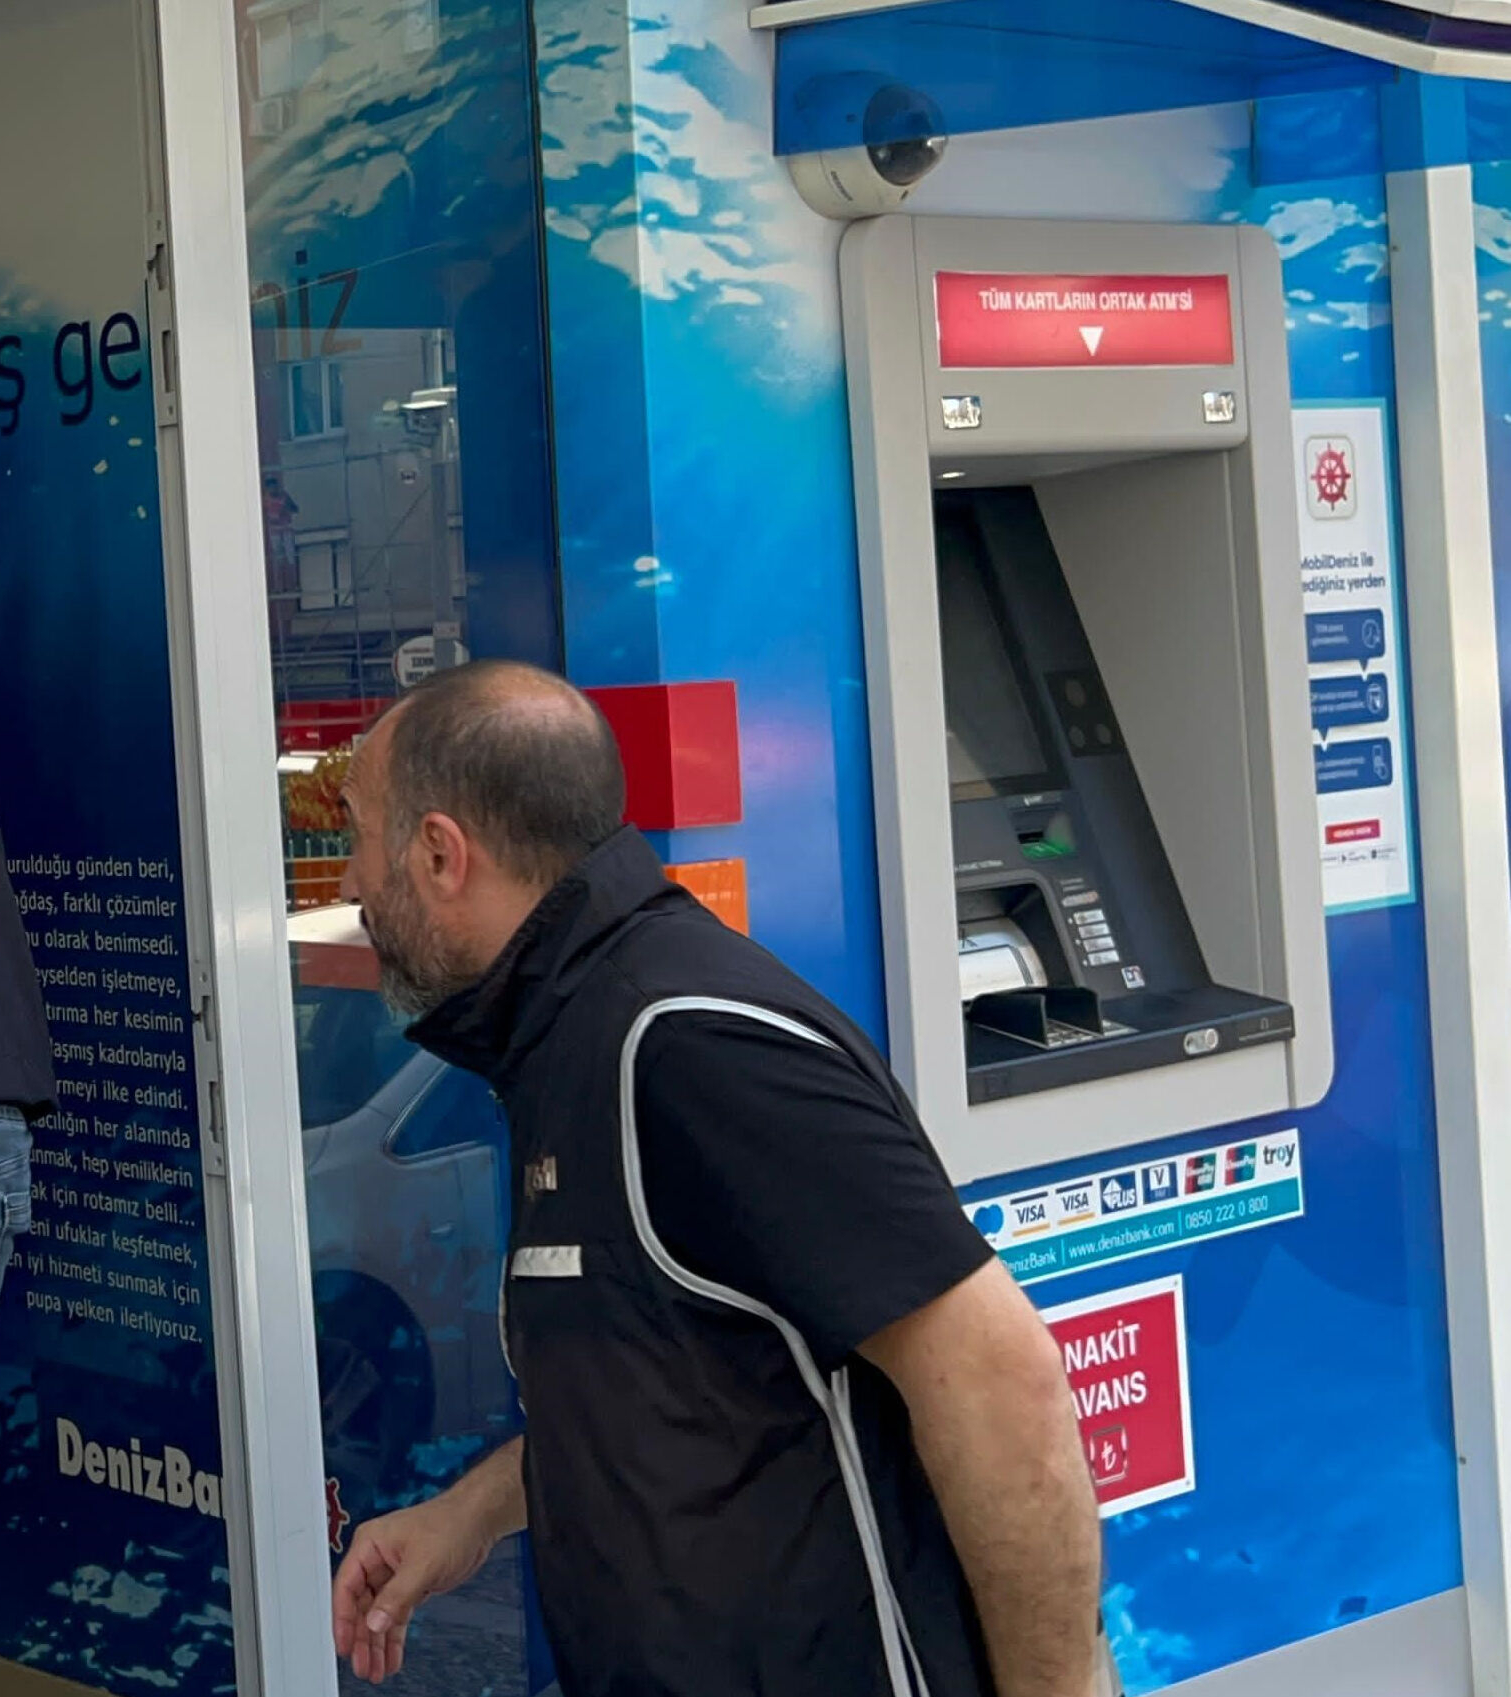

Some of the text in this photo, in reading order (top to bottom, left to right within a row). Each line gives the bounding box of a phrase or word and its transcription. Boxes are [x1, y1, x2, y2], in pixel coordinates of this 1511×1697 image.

[979, 288, 1012, 311] TÜM
[1015, 291, 1096, 311] KARTLARIN
[1100, 291, 1146, 311] ORTAK
[53, 311, 150, 427] ge
[1348, 573, 1386, 592] yerden
[76, 857, 132, 880] günden
[138, 857, 174, 883] beri,
[63, 891, 101, 914] farklı
[106, 894, 177, 919] çözümler
[45, 929, 89, 949] olarak
[95, 931, 178, 956] benimsedi.
[102, 969, 181, 999] işletmeye,
[94, 1004, 118, 1026] her
[124, 1008, 183, 1033] kesimin
[99, 1042, 186, 1074] kadrolarıyla
[103, 1080, 129, 1102] ilke
[135, 1085, 188, 1110] edindi.
[94, 1116, 118, 1138] her
[124, 1122, 191, 1149] alanında
[83, 1151, 109, 1175] hep
[113, 1158, 193, 1188] yeniliklerin
[1263, 1143, 1295, 1168] troy
[1154, 1168, 1165, 1186] V
[52, 1184, 77, 1209] için
[83, 1191, 139, 1217] rotamız
[145, 1201, 195, 1227] belli...
[1016, 1203, 1046, 1225] VISA
[1062, 1191, 1089, 1212] VISA
[1113, 1188, 1137, 1210] PLUS
[1068, 1219, 1174, 1258] www.denizbank.com
[1185, 1209, 1212, 1230] 0850
[1216, 1203, 1235, 1223] 222
[1239, 1202, 1246, 1217] 0
[1248, 1194, 1268, 1213] 800
[55, 1220, 106, 1245] ufuklar
[112, 1229, 197, 1269] keşfetmek,
[28, 1251, 44, 1276] iyi
[49, 1255, 102, 1285] hizmeti
[107, 1268, 167, 1299] sunmak
[172, 1278, 200, 1306] için
[26, 1289, 203, 1344] pupa yelken ilerliyoruz.
[1064, 1319, 1140, 1374] NAKİT
[55, 1416, 227, 1521] DenizBa
